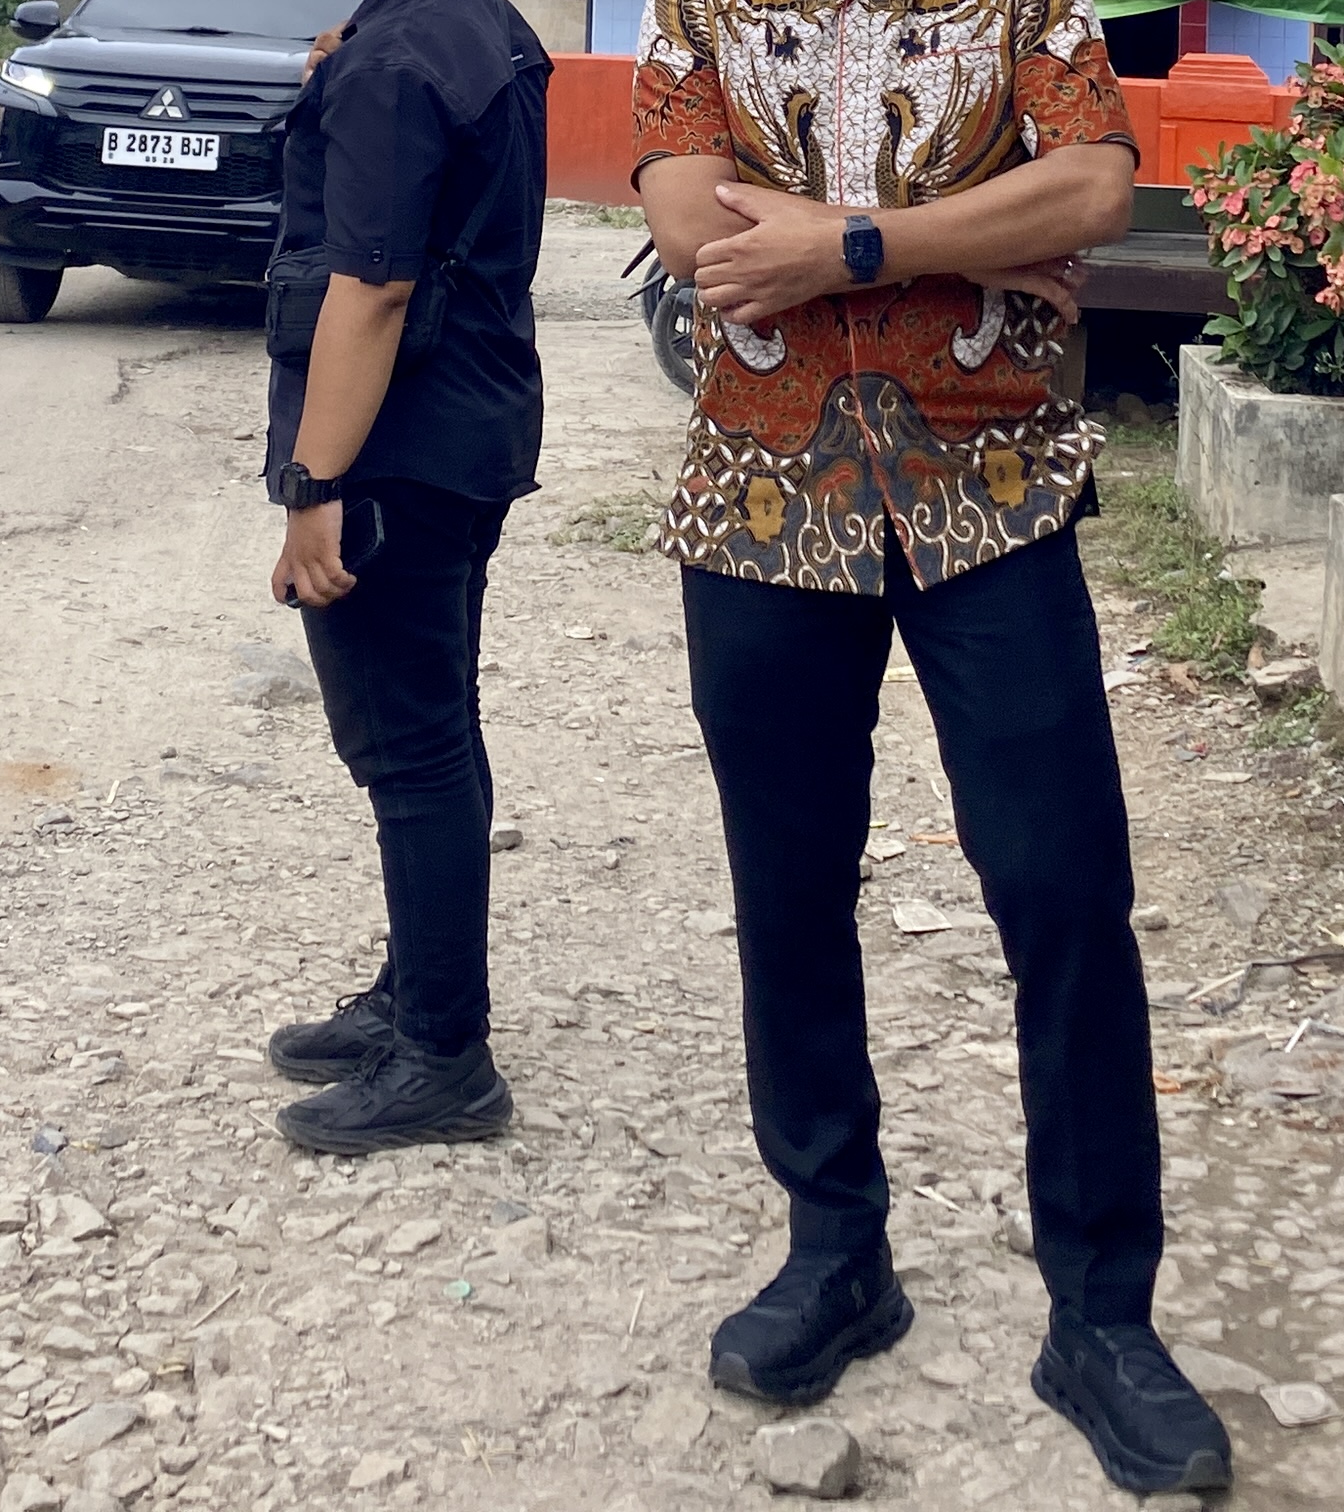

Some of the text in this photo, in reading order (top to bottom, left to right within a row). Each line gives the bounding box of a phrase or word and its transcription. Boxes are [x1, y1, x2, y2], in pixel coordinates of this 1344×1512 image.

[108, 132, 215, 157] B 2873 BJF
